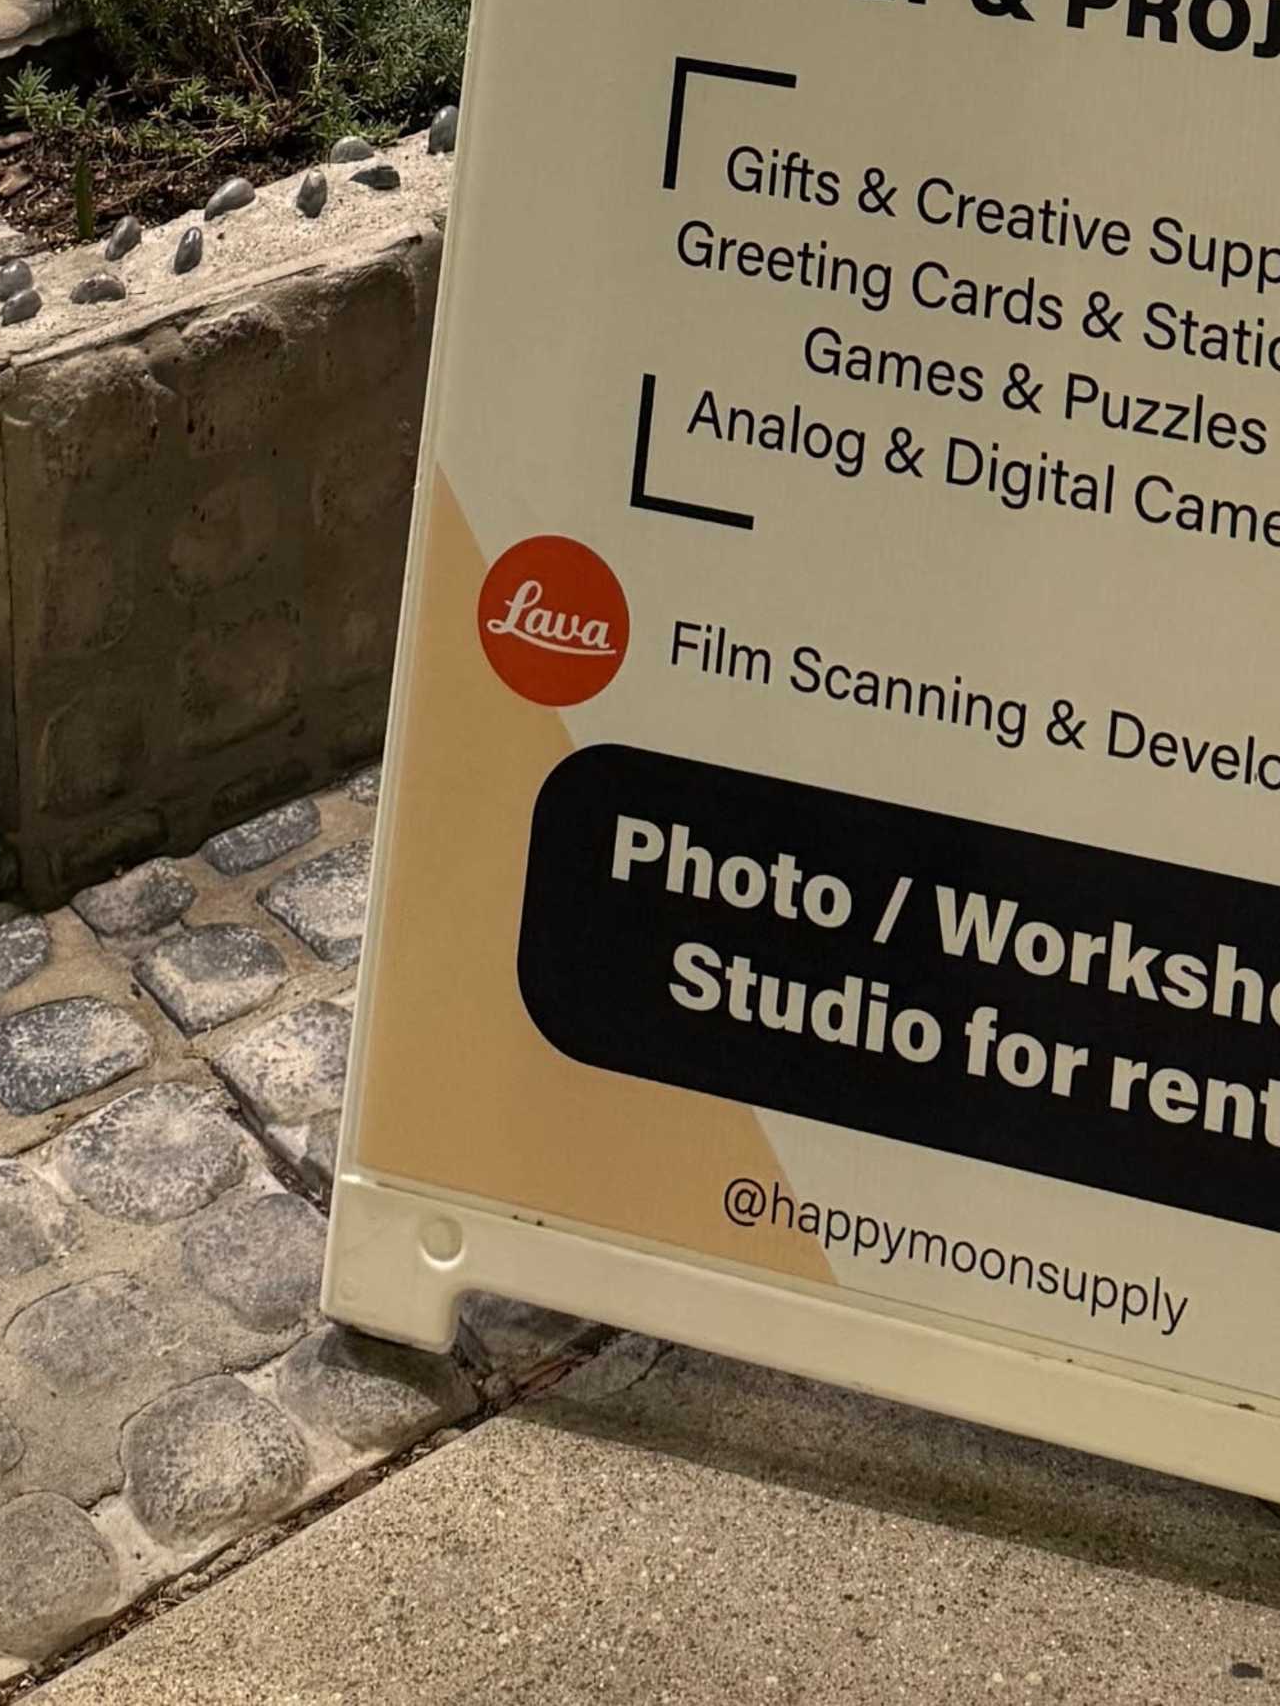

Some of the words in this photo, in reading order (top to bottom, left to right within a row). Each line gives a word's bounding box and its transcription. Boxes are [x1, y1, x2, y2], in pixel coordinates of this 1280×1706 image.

[727, 146, 841, 206] Gifts
[857, 168, 899, 217] &
[916, 177, 1132, 257] Creative
[676, 220, 893, 312] Greeting
[912, 262, 1064, 331] Cards
[1082, 291, 1124, 343] &
[686, 390, 867, 477] Analog
[885, 427, 926, 478] &
[946, 438, 1115, 514] Digital
[804, 326, 985, 402] Games
[1002, 363, 1043, 414] &
[1066, 374, 1268, 454] Puzzles
[486, 579, 617, 656] Lava
[671, 620, 772, 685] Film
[789, 647, 1029, 748] Scanning
[1046, 699, 1088, 751] &
[611, 813, 852, 931] Photo
[873, 876, 912, 943] /
[669, 942, 942, 1063] Studio
[965, 1006, 1088, 1100] for
[722, 1176, 1190, 1336] @happymoonsupply
